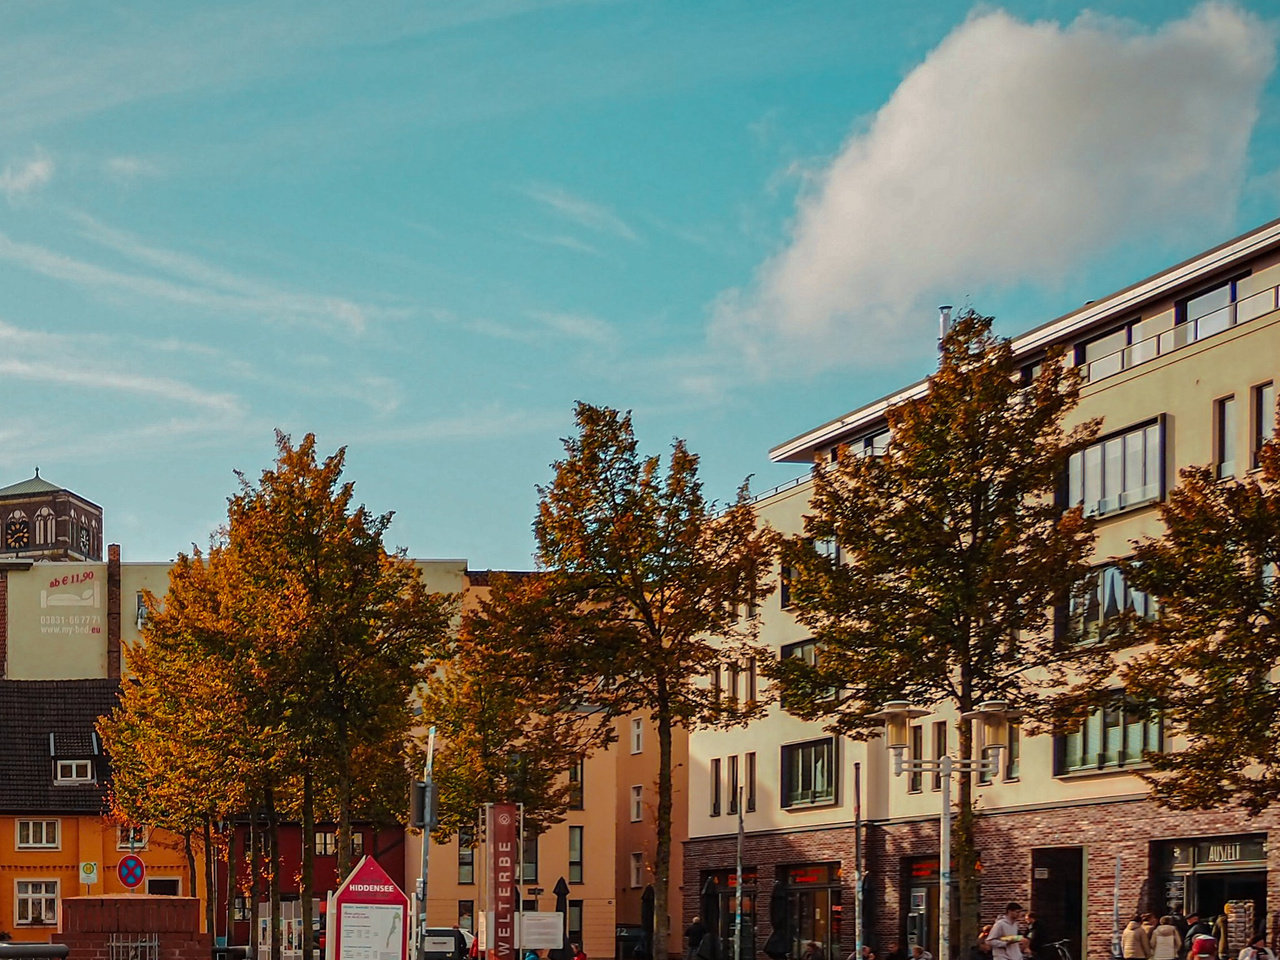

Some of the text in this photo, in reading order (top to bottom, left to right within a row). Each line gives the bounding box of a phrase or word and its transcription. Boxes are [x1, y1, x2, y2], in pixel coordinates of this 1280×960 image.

[49, 571, 94, 588] ab € 11,90
[349, 884, 395, 893] HIDDENSEE
[498, 841, 511, 956] WELTERBE
